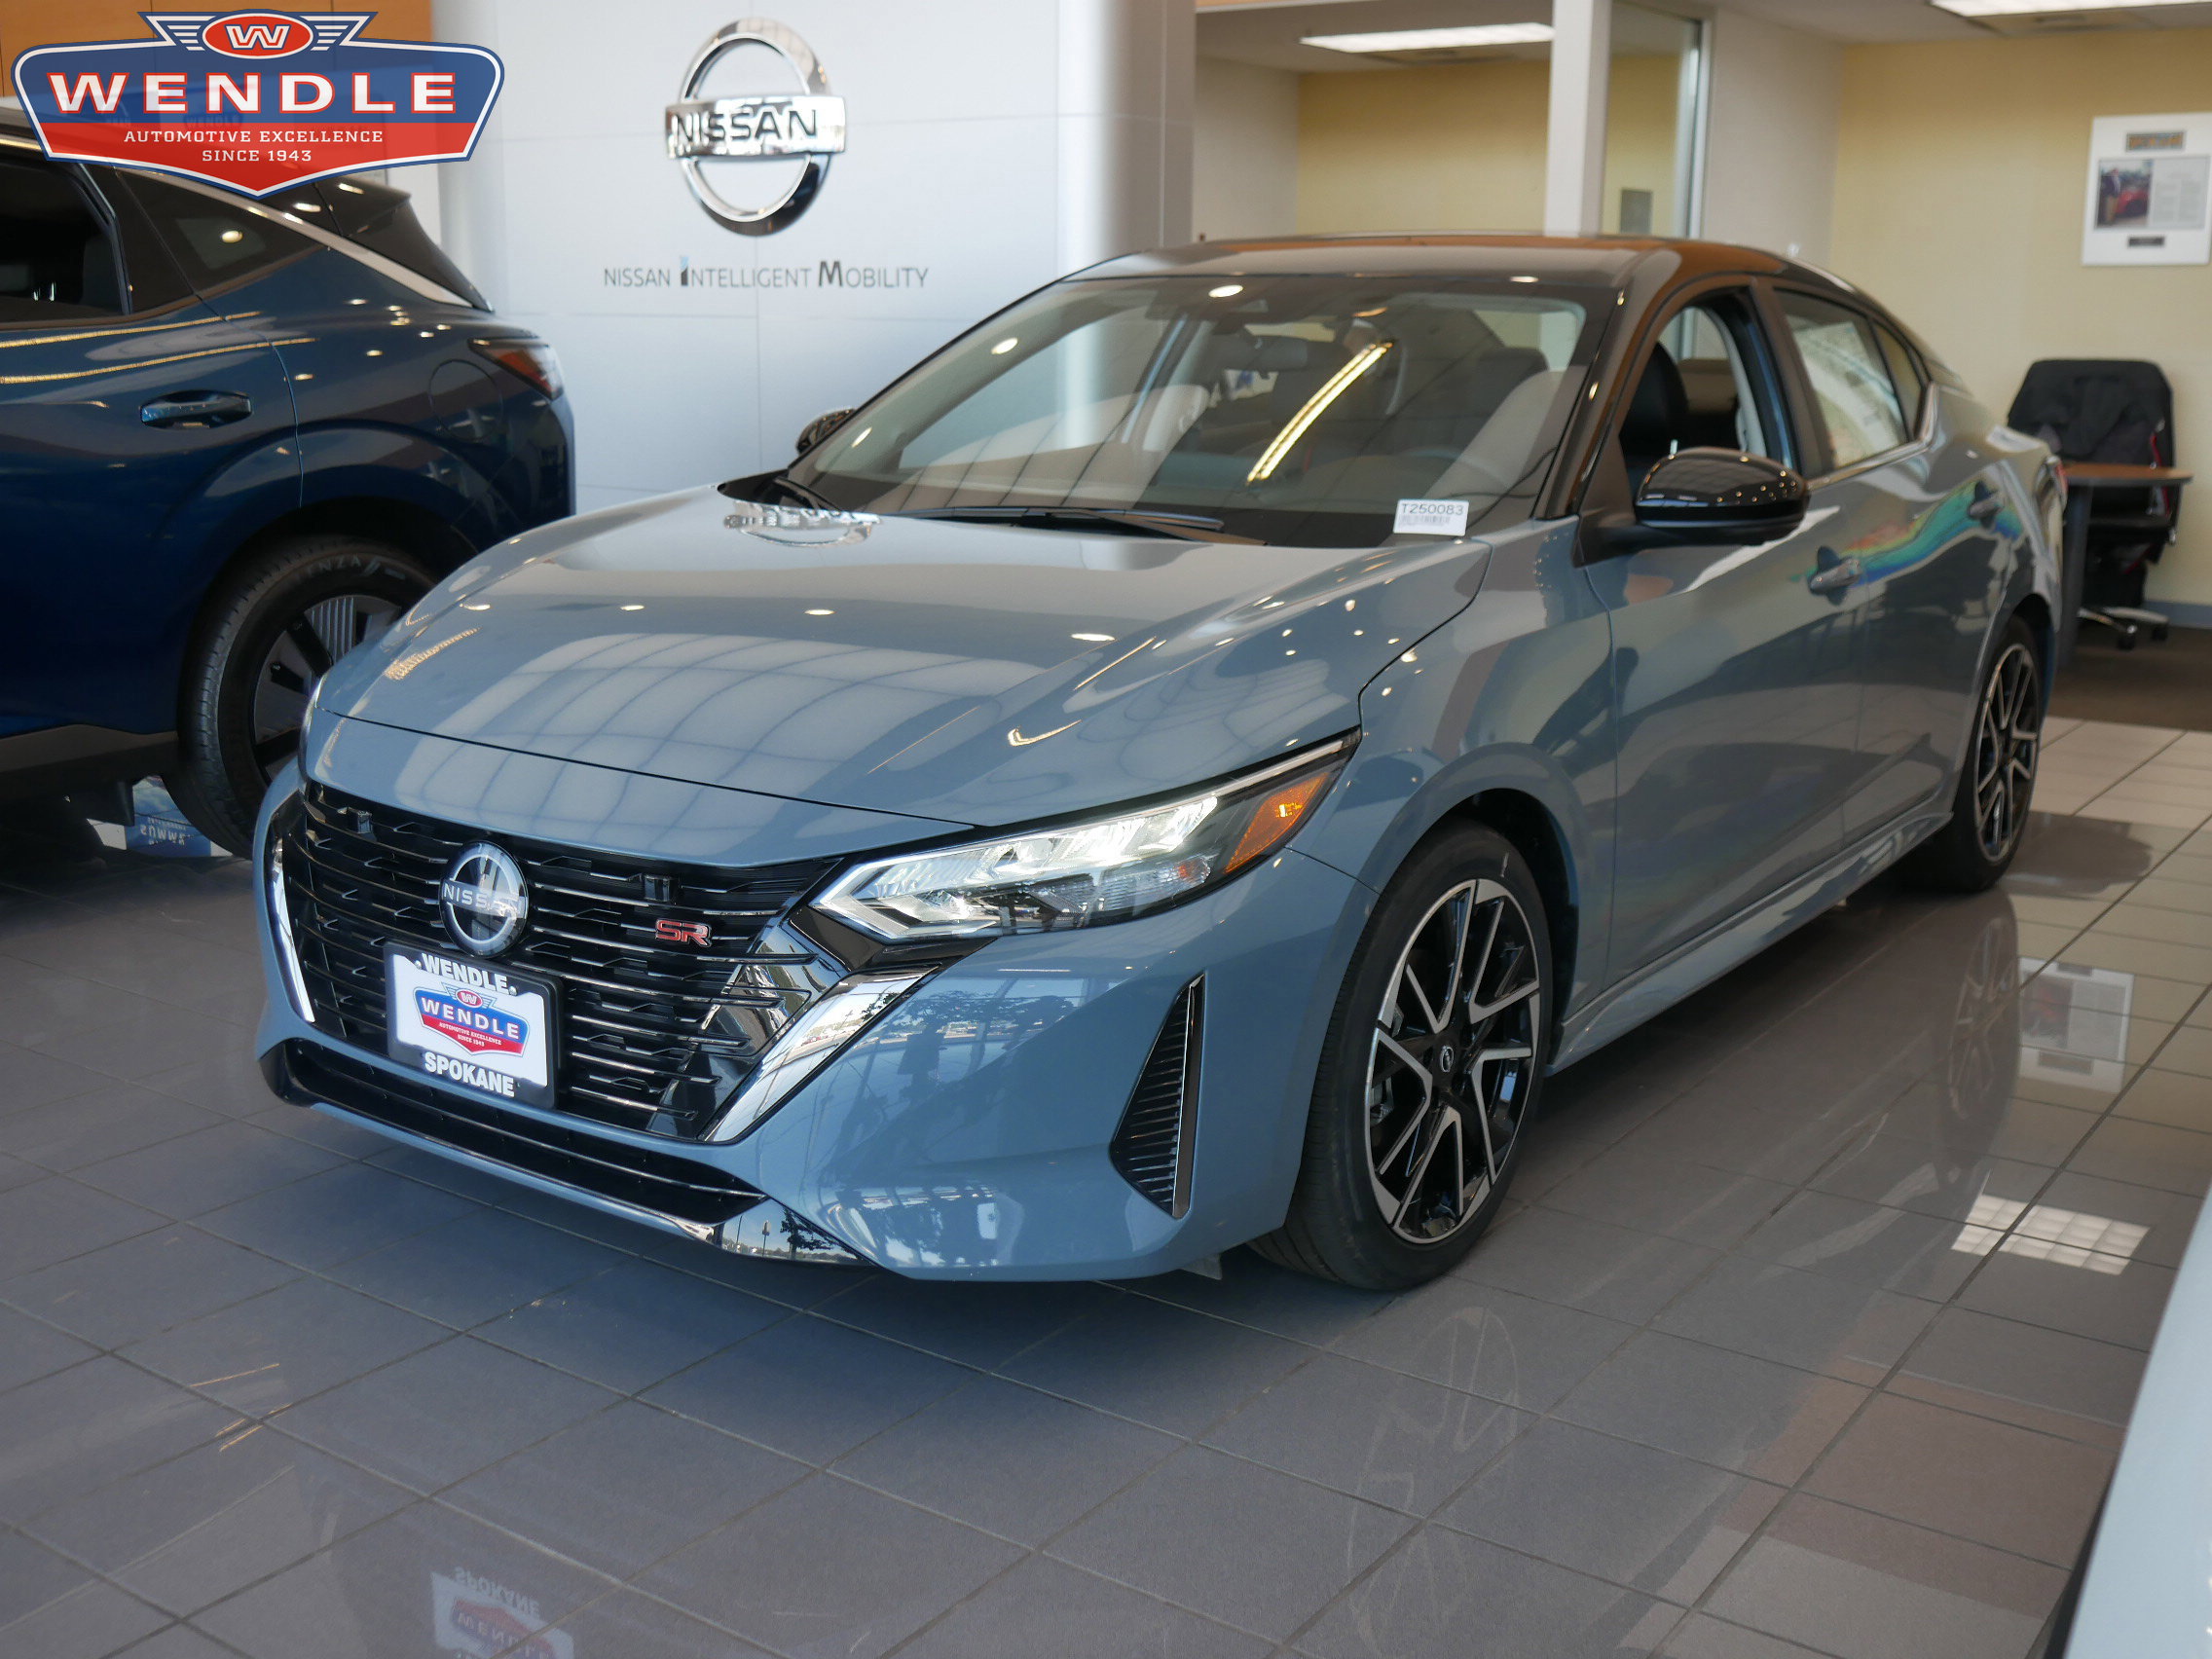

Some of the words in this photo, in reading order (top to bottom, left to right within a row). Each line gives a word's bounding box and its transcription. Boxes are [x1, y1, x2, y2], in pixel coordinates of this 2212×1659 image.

[673, 109, 818, 143] NISSAN
[604, 268, 670, 287] NISSAN
[1402, 503, 1463, 515] T250083
[655, 919, 712, 947] SR
[422, 953, 508, 995] WENDLE
[421, 997, 519, 1040] WENDLE
[439, 1022, 470, 1036] AUTOMOTIVE
[470, 1030, 502, 1046] EXCELLENCE
[458, 1034, 472, 1043] SINCE
[424, 1051, 515, 1097] SPOKANE
